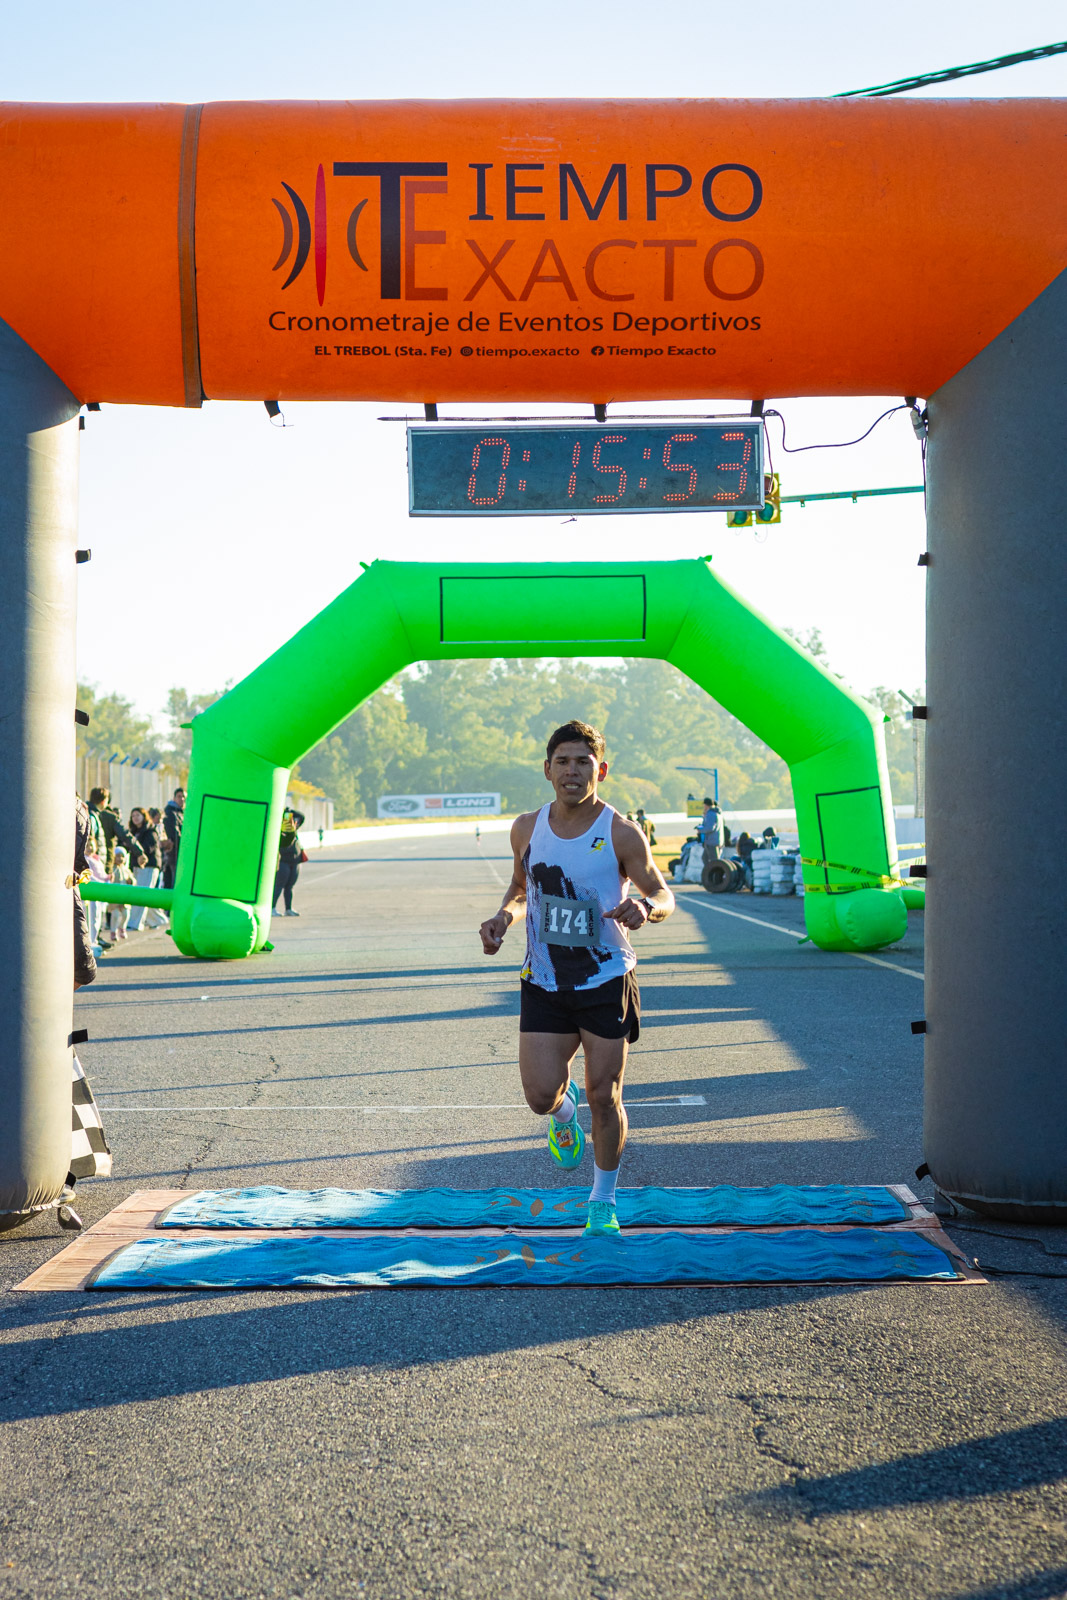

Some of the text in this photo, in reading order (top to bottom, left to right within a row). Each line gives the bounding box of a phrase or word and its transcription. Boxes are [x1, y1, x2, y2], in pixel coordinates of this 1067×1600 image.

[404, 180, 765, 302] EXACTO
[268, 311, 762, 337] Cronometraje de Eventos Deportivos
[314, 345, 452, 358] EL TREBOL (Sta. Fe)
[475, 345, 580, 358] tiempo.exacto
[607, 345, 717, 358] Tiempo Exacto
[550, 907, 587, 934] 174
